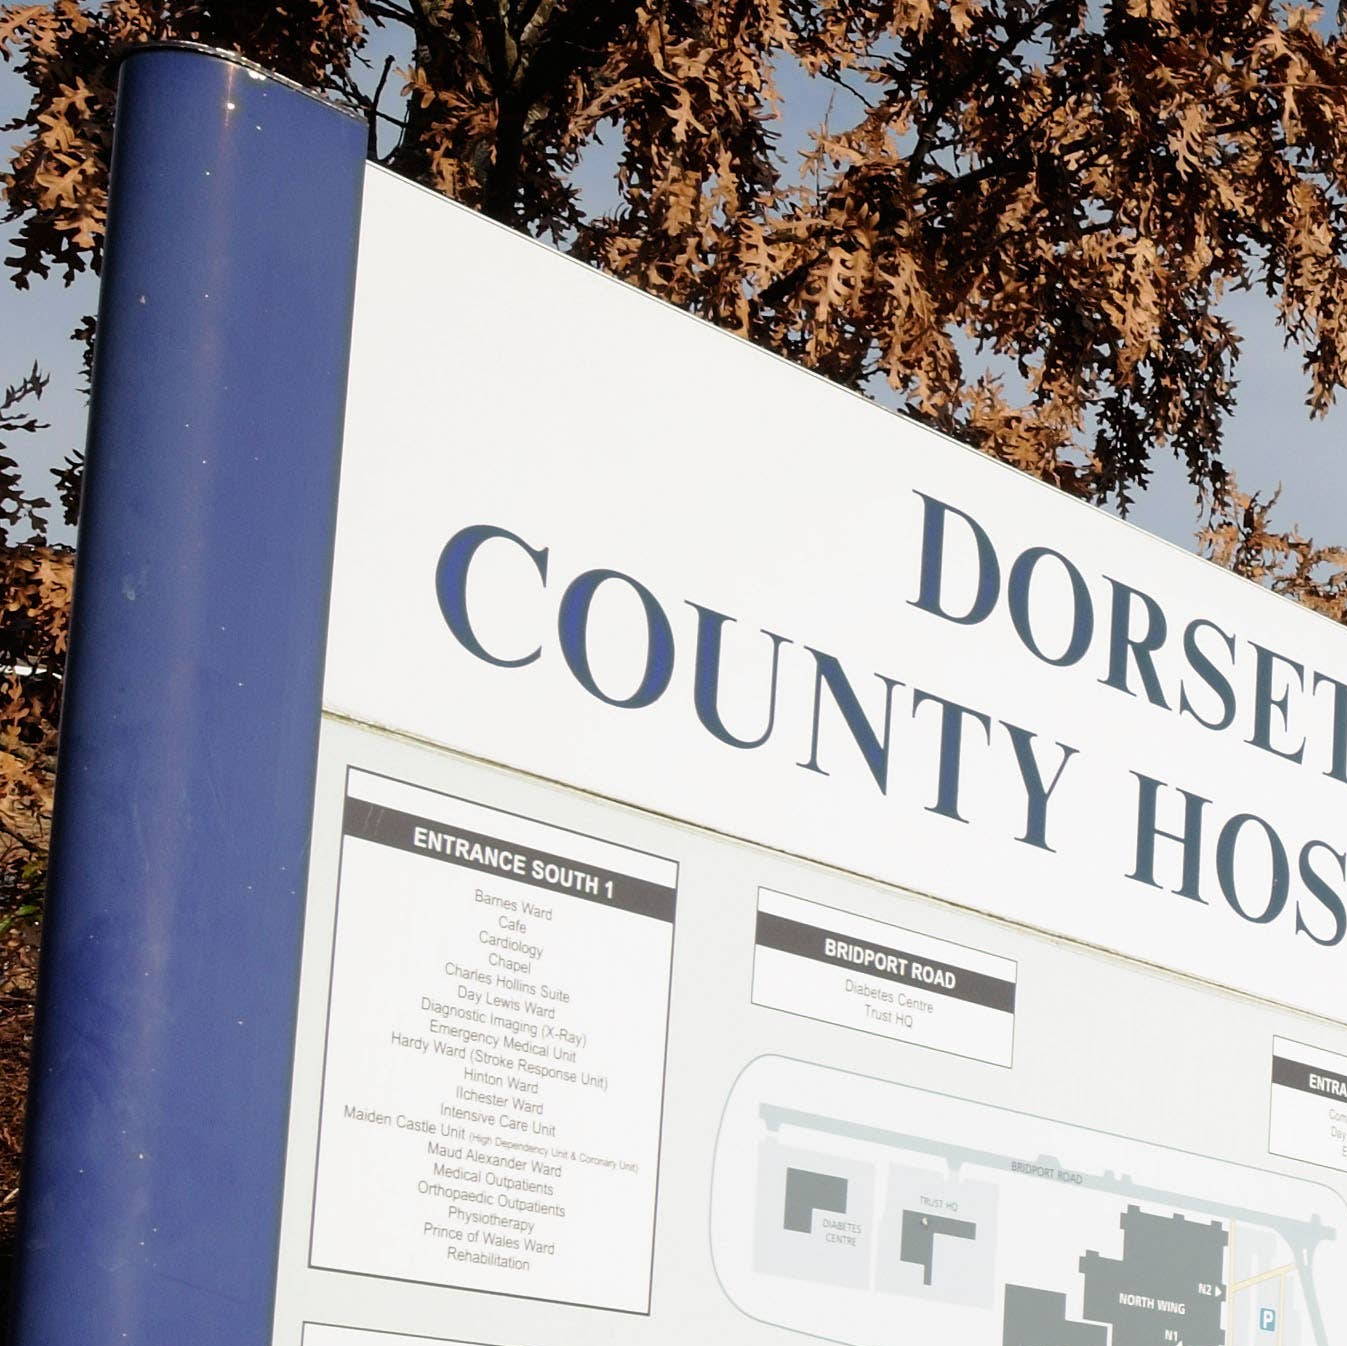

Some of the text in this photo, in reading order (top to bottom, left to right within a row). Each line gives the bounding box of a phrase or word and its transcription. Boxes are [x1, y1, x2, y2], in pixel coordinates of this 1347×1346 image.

[434, 523, 1080, 856] COUNTY
[413, 826, 612, 898] ENTRANCE SOUTH 1
[474, 887, 552, 921] Barnes Ward
[497, 914, 526, 934] Cafe
[478, 929, 543, 960] Cardiology
[487, 951, 531, 974] Chapel
[824, 938, 955, 989] BRIDPORT ROAD
[444, 961, 570, 1003] Charles Hollins Suite
[844, 978, 933, 1013] Diabetes Centre
[457, 984, 555, 1019] Day Lewis Ward
[864, 1003, 913, 1028] Trust HQ
[420, 995, 586, 1048] Diagnostic Imaging (X-Ray)
[428, 1018, 576, 1063] Emergency Medical Unit
[391, 1030, 607, 1090] Hardy Ward (Stroke Response Unit)
[463, 1066, 538, 1094] Hinton Ward
[455, 1085, 543, 1115] Ilchester Ward
[343, 1104, 465, 1139] Maiden Castle Unit
[439, 1102, 556, 1137] Intensive Care Unit
[427, 1140, 562, 1177] Maud Alexander Ward
[1011, 1160, 1083, 1185] BRIDPORT ROAD
[432, 1162, 553, 1196] Medical Outpatients
[417, 1179, 565, 1217] Orthopaedic Outpatients
[447, 1204, 534, 1235] Physiotherapy
[423, 1221, 554, 1255] Prince of Wales Ward
[446, 1245, 530, 1270] Rehabilitation
[1119, 1292, 1186, 1315] NORTH WING
[1198, 1283, 1212, 1296] N2
[1165, 1329, 1178, 1342] N1
